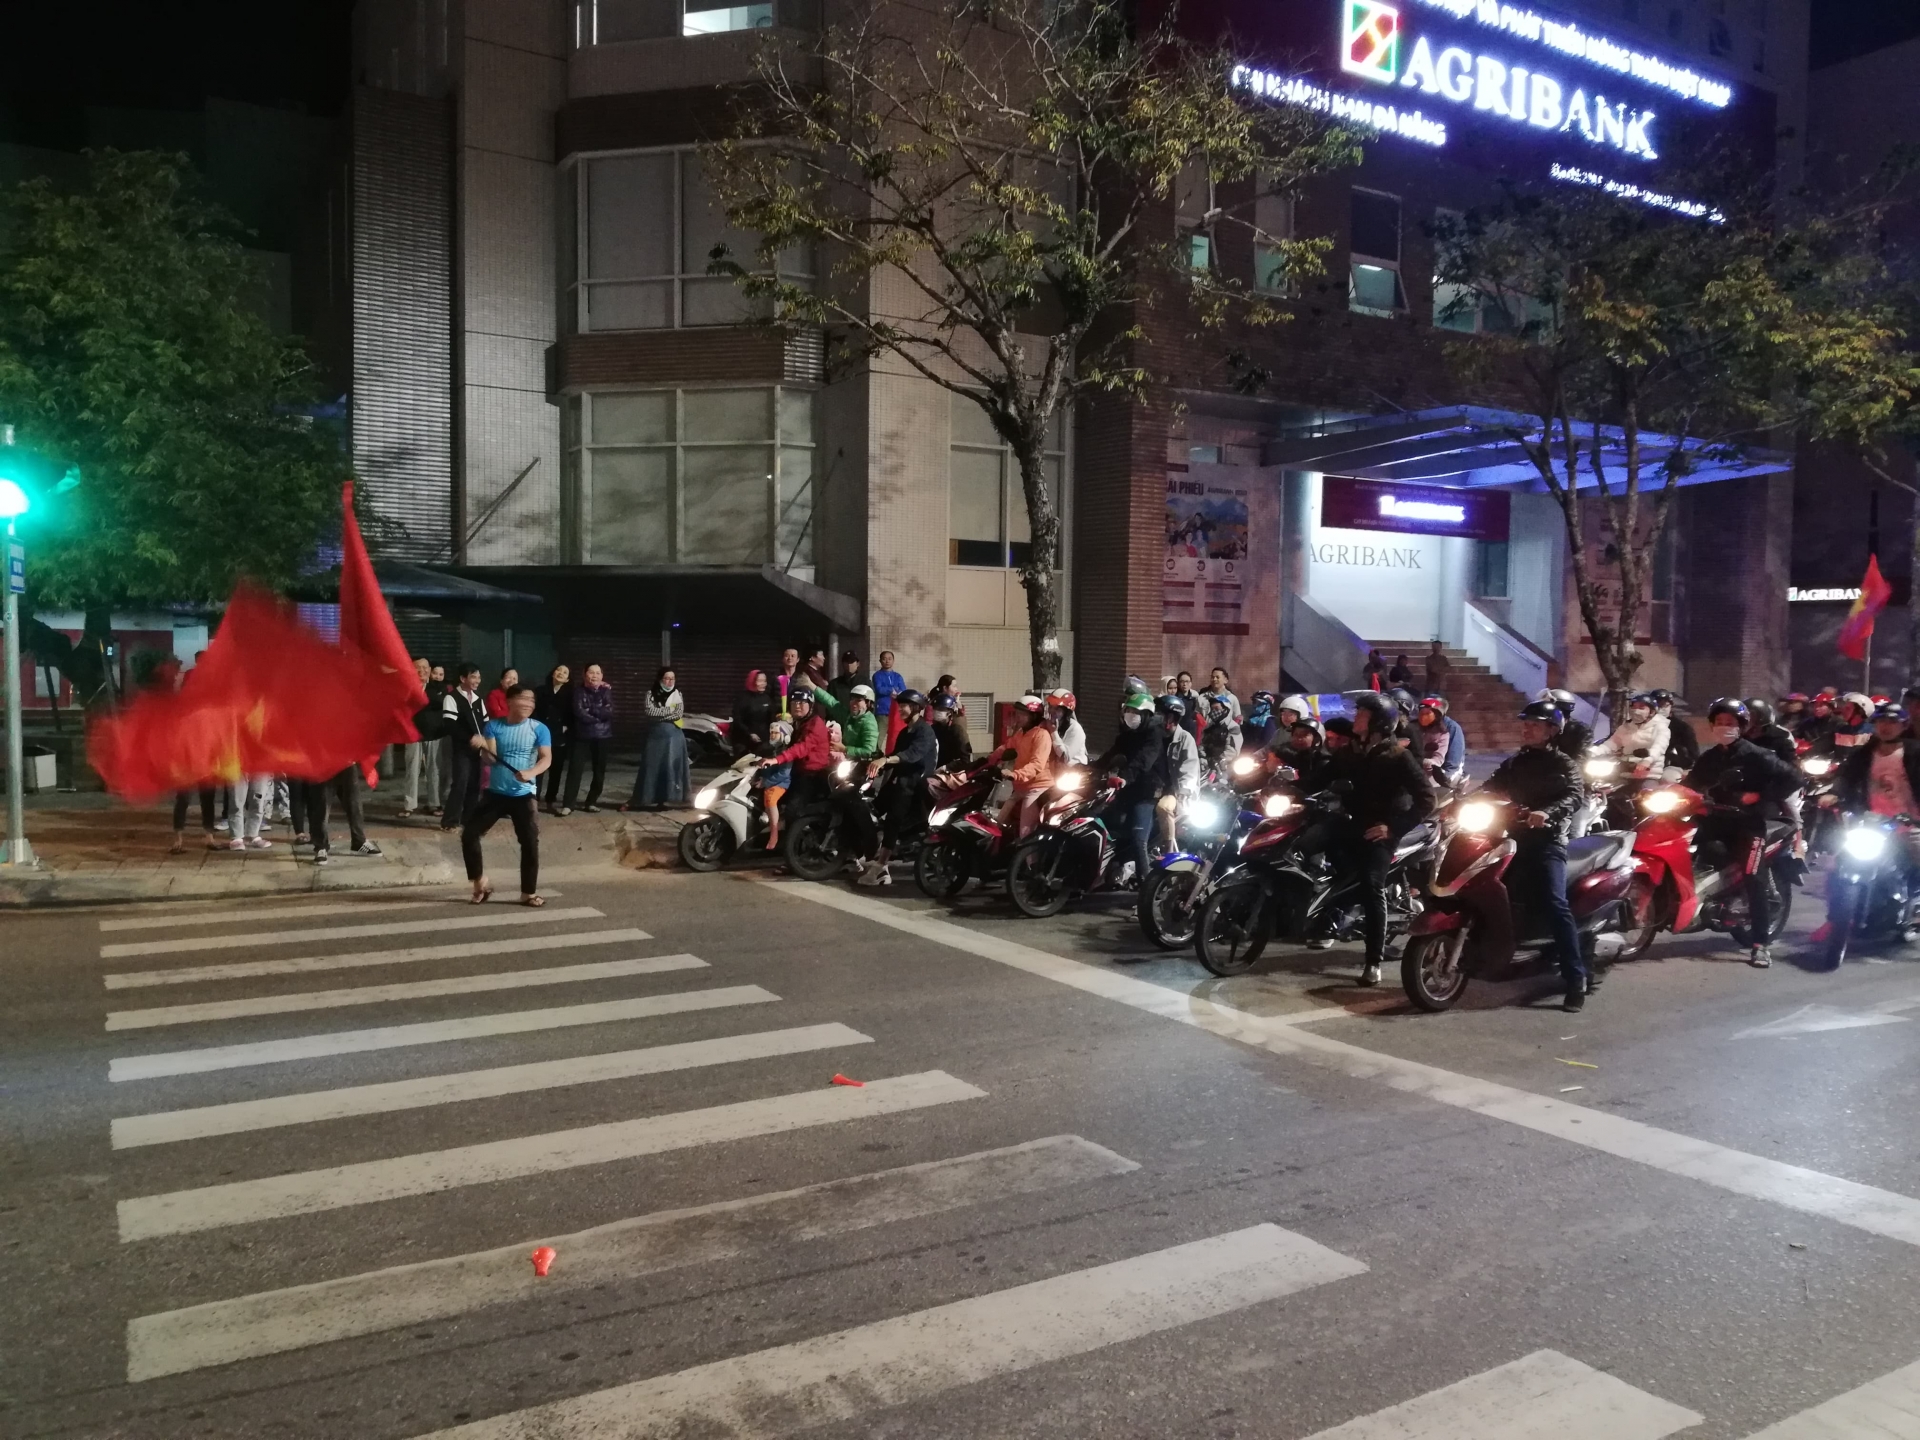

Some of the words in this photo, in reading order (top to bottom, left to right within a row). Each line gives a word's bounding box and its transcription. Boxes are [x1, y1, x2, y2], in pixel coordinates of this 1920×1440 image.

[1400, 36, 1658, 160] AGRIBANK
[1309, 542, 1422, 569] AGRIBANK
[1797, 588, 1863, 601] AGRIBAN
